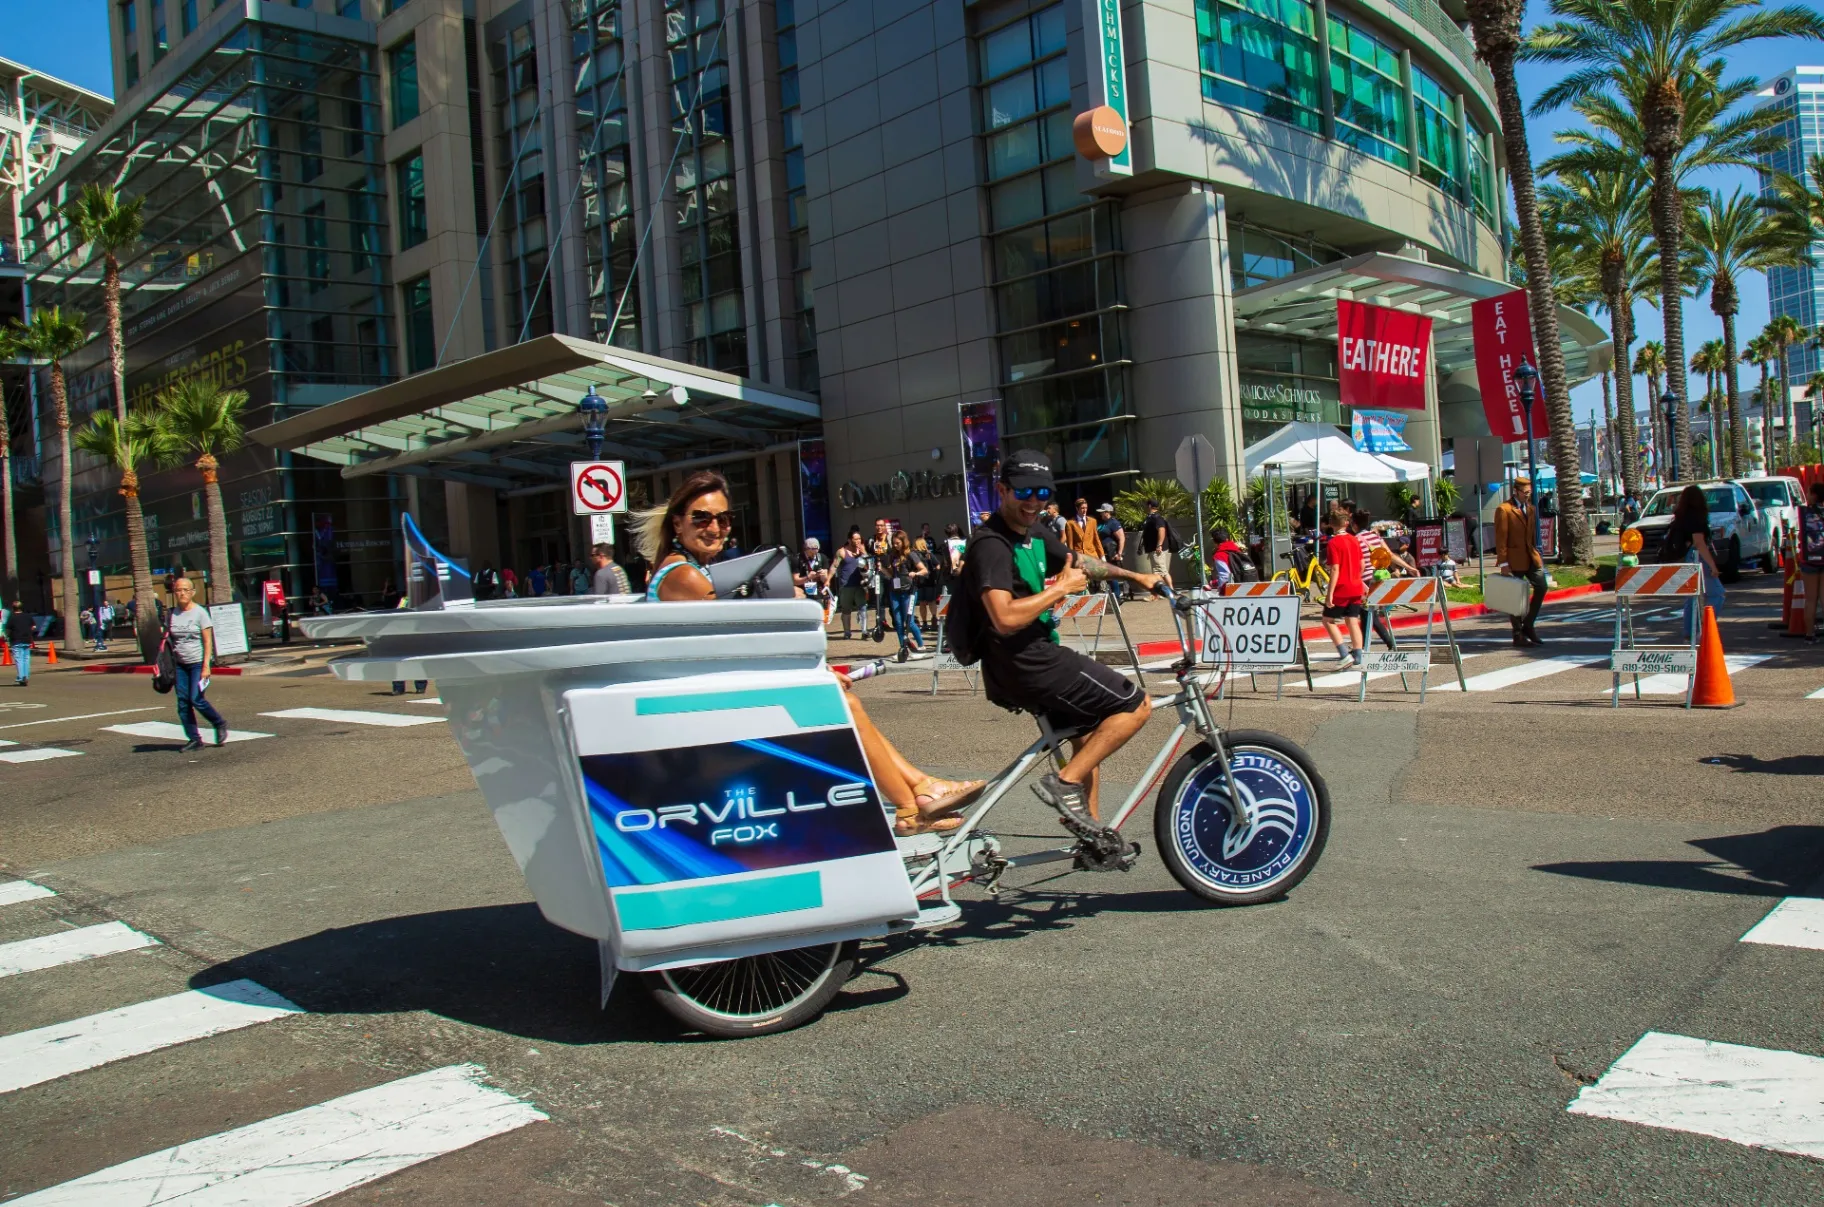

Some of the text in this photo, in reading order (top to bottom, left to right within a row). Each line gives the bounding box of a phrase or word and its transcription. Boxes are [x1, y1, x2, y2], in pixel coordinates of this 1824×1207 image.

[167, 302, 180, 316] DAVID
[208, 281, 220, 293] JACK
[1494, 301, 1519, 413] EAT HERE
[240, 489, 267, 508] SEASON
[242, 506, 274, 523] AUGUST 22
[1222, 606, 1281, 626] ROAD
[1208, 633, 1292, 654] CLOSED
[1366, 663, 1419, 671] 619-299-5100
[1378, 652, 1409, 663] ACME
[1637, 651, 1674, 663] ACME
[1622, 663, 1688, 673] 619-299-5100
[1233, 755, 1301, 792] ORVILLE
[724, 786, 757, 798] THE
[614, 782, 868, 833] ORVILLE
[711, 822, 778, 846] FOX
[1180, 810, 1291, 883] PLANETARY UNION
